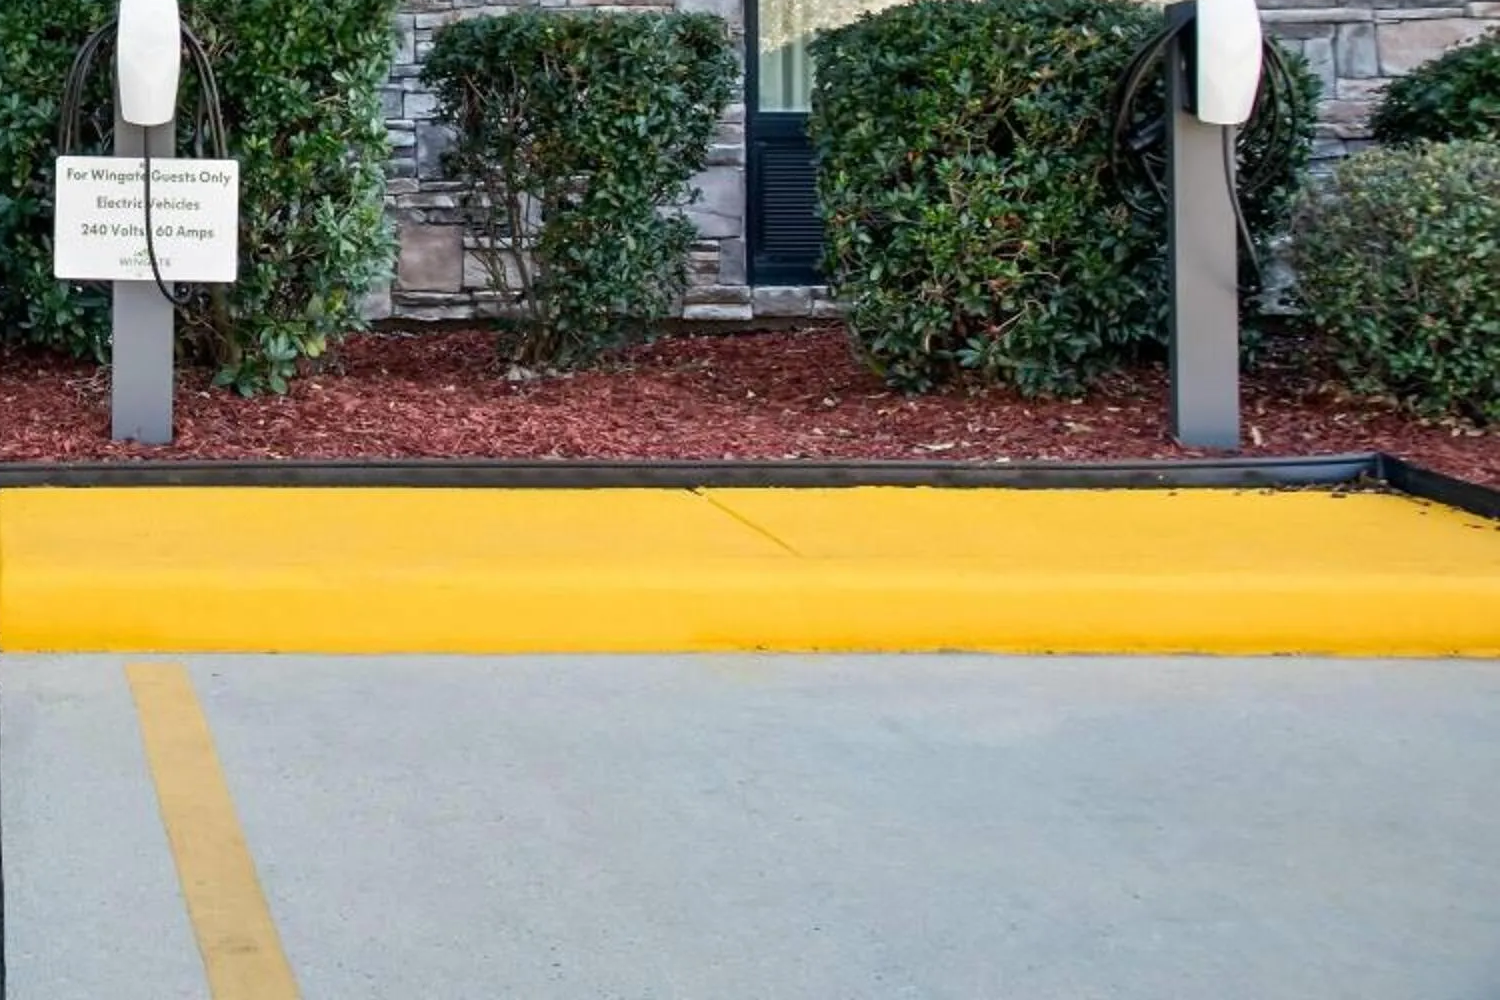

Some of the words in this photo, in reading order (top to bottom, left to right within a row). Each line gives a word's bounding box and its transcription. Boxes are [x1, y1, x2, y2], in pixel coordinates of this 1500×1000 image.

[67, 168, 88, 181] For
[152, 169, 196, 183] Guests
[199, 171, 232, 187] Only
[96, 196, 143, 209] Electric
[81, 223, 108, 237] 240
[155, 226, 173, 238] 60
[176, 227, 215, 241] Amps
